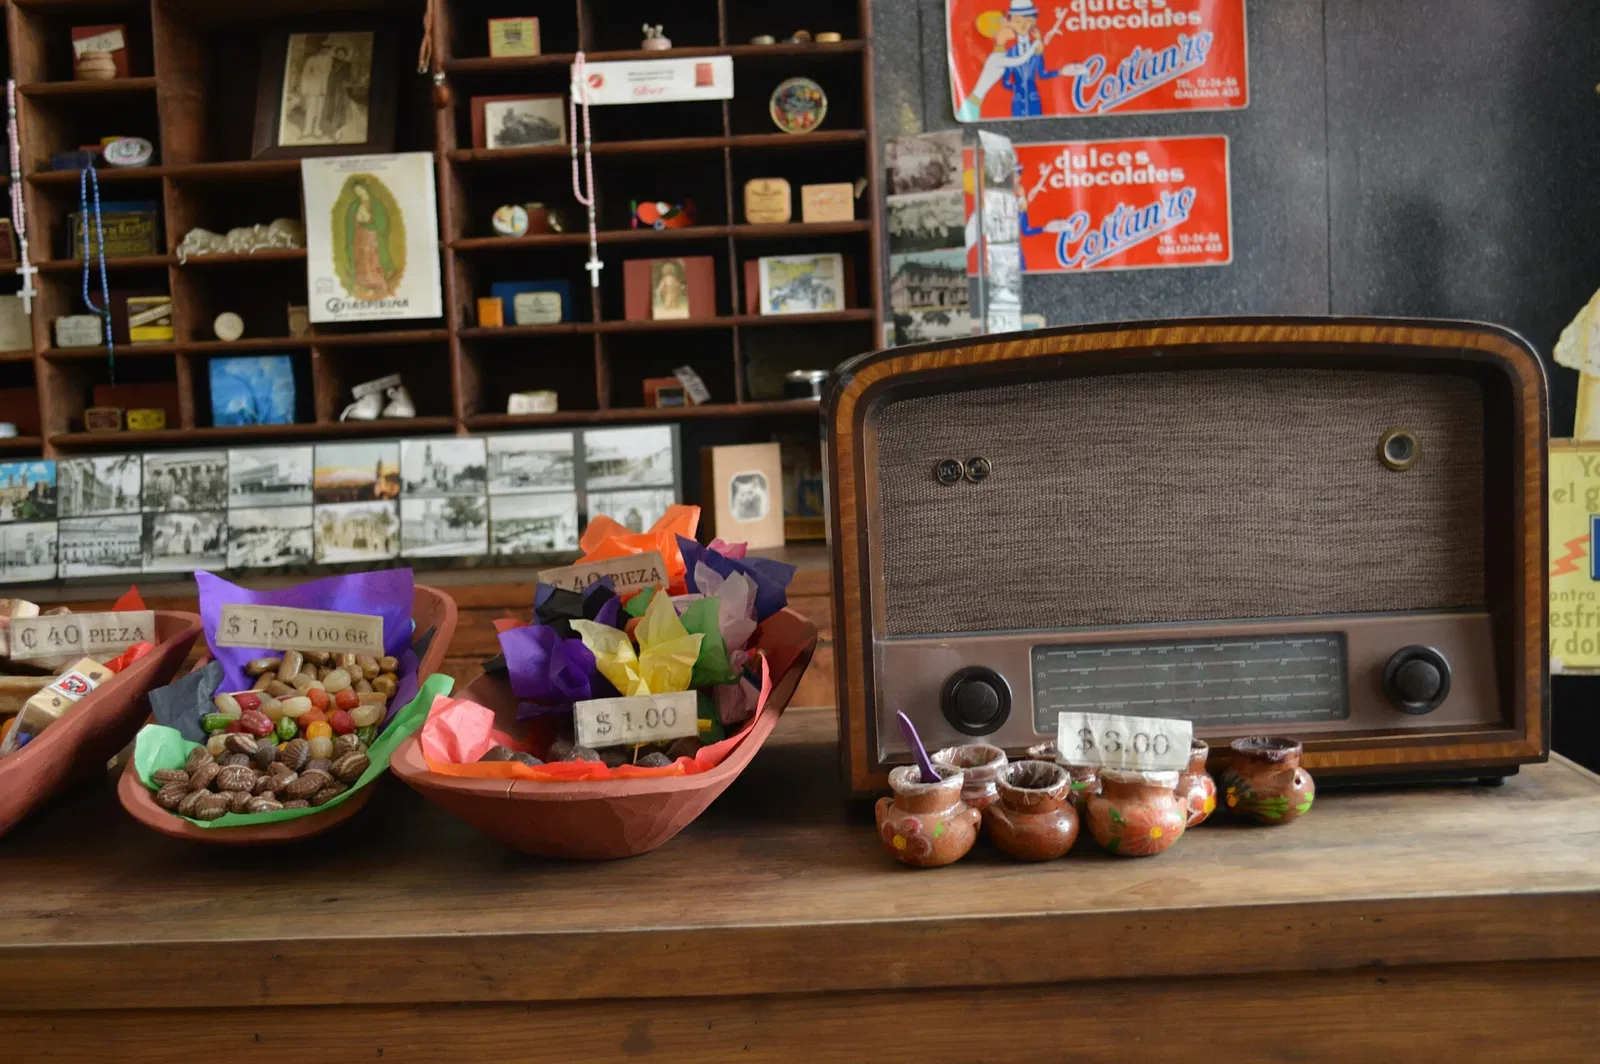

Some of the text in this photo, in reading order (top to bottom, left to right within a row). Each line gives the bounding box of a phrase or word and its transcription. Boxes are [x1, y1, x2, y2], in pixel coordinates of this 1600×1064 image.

[1070, 0, 1166, 13] dulces
[1066, 8, 1202, 31] chocolates
[1072, 31, 1213, 112] Costanzo
[1055, 148, 1149, 169] dulces
[1050, 164, 1185, 188] chocolates
[1056, 186, 1197, 267] Costanzo
[1552, 481, 1576, 504] el
[608, 567, 663, 587] PIEZA
[47, 625, 80, 646] 40
[89, 627, 145, 643] PIEZA
[250, 618, 299, 639] 1.50
[308, 626, 339, 642] 100
[345, 628, 373, 645] GR.
[622, 707, 677, 731] 1.00
[1104, 730, 1170, 756] 3.00
